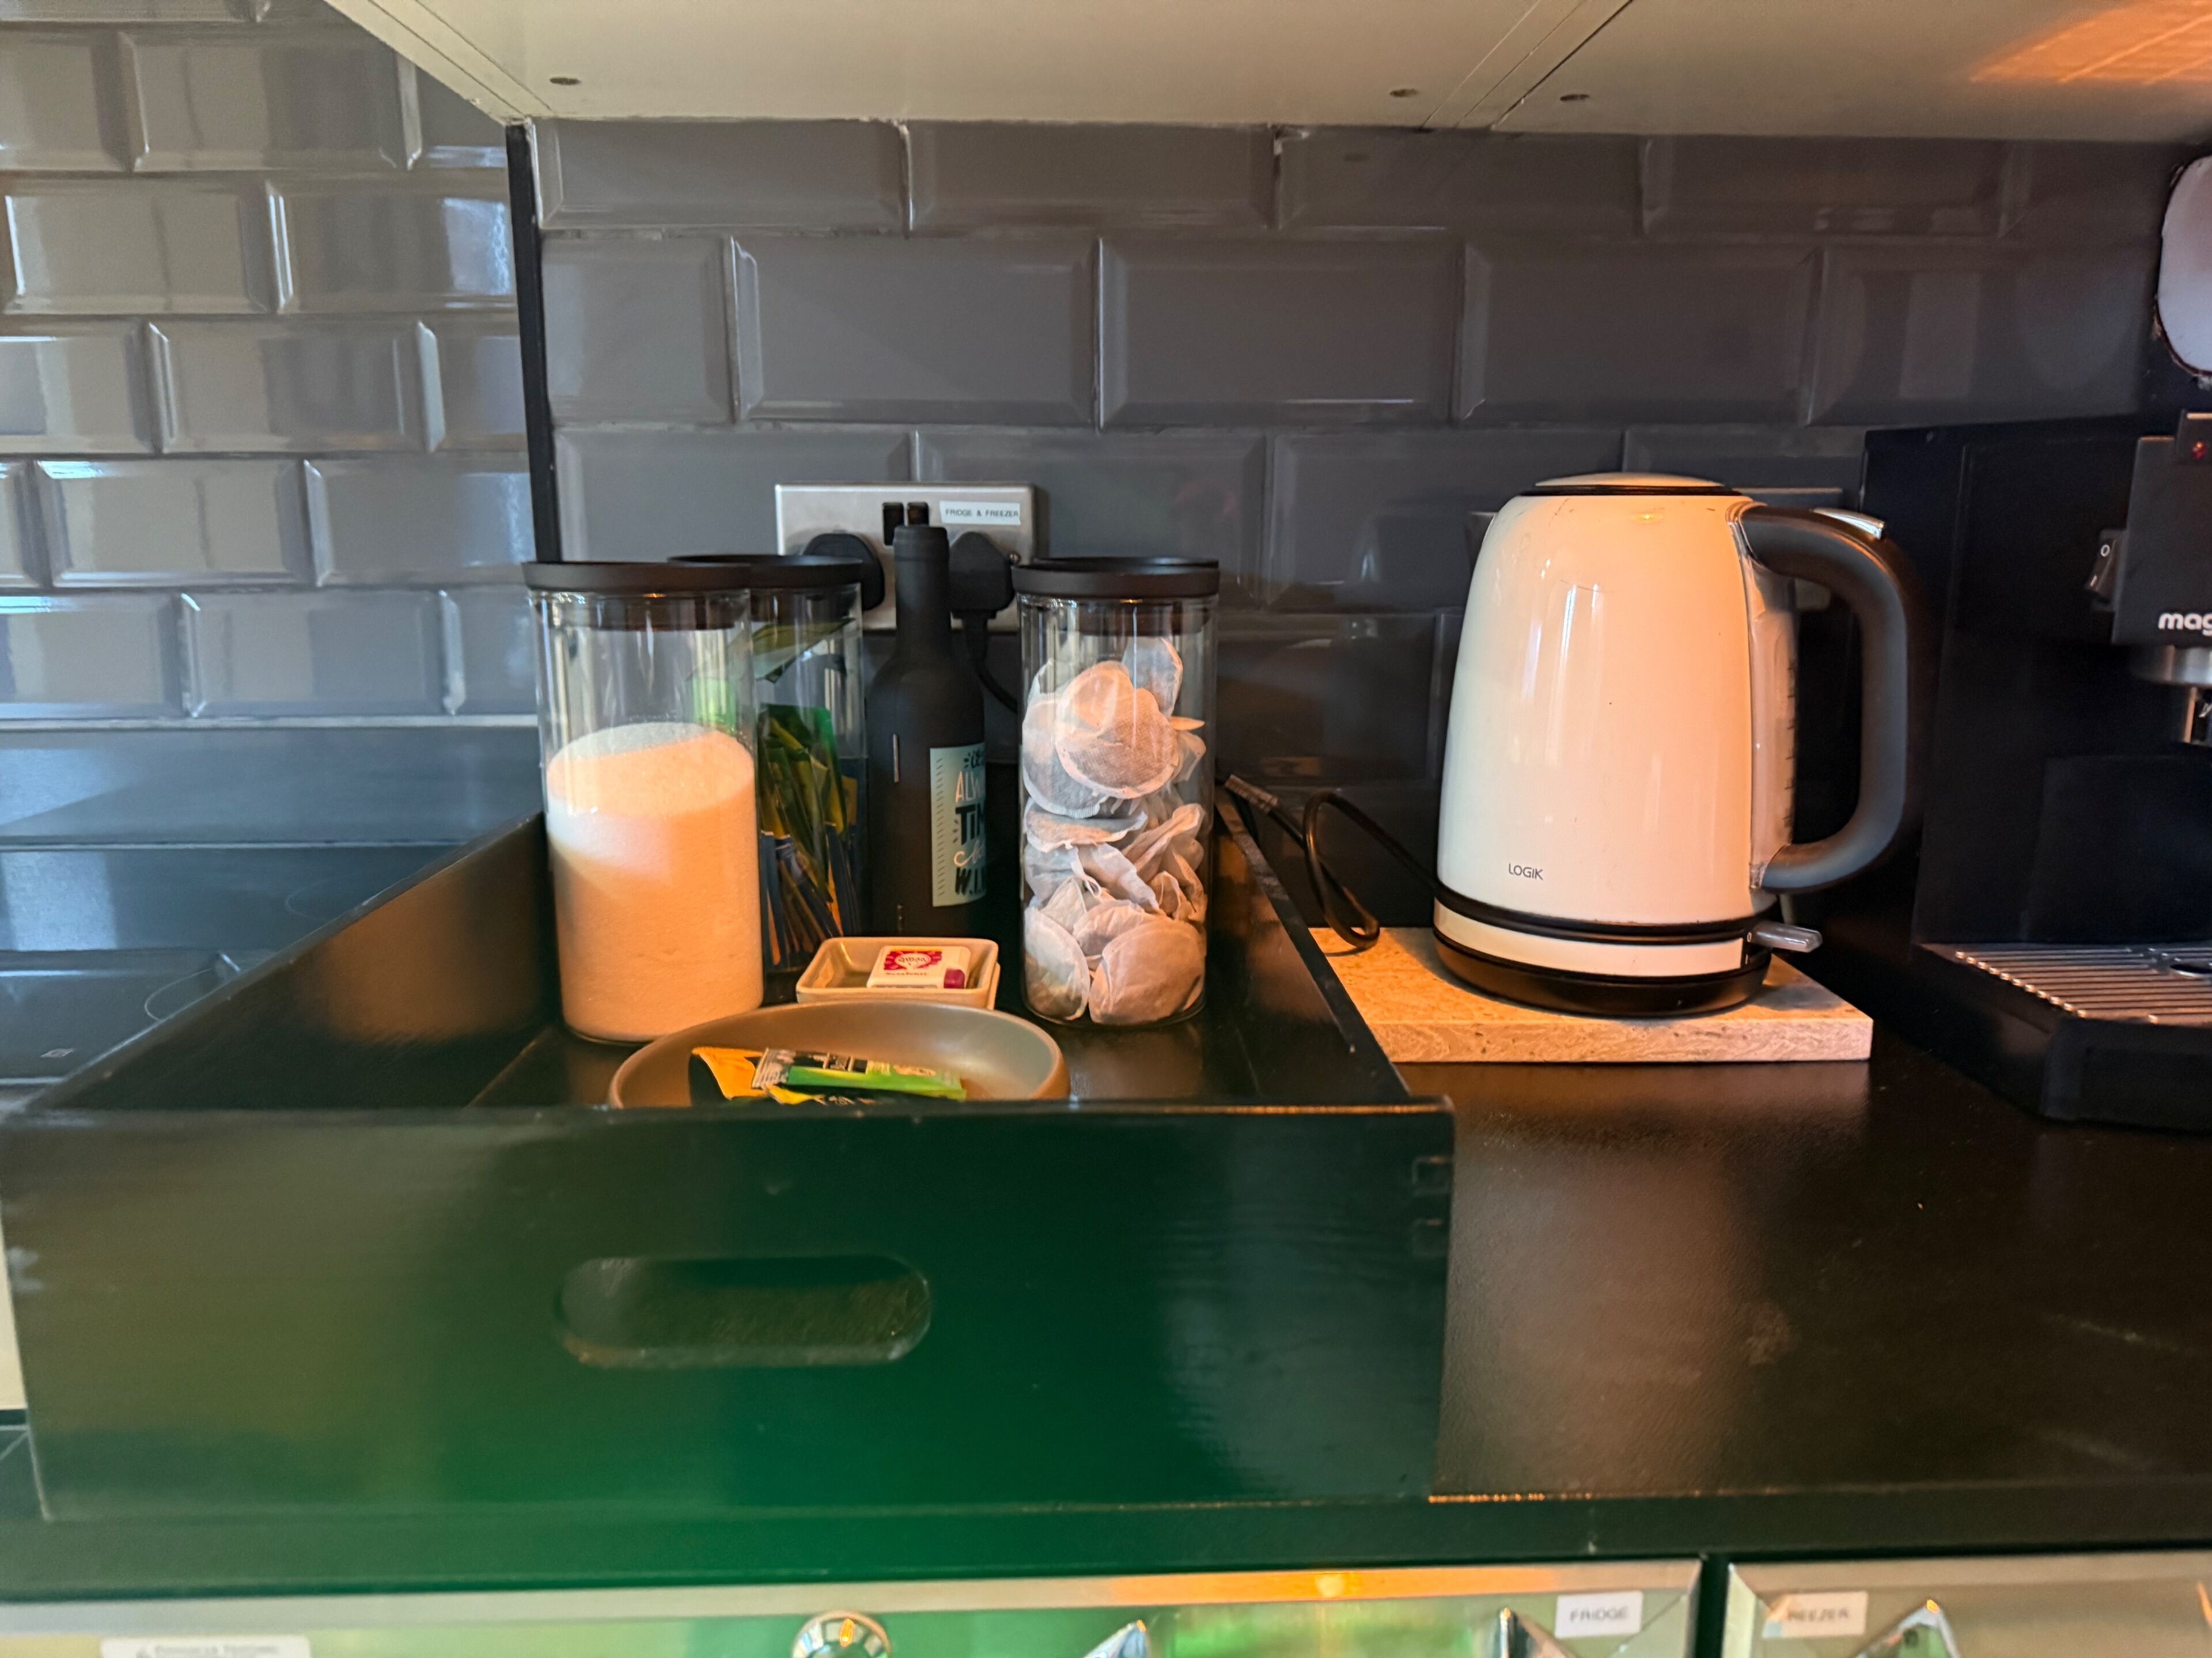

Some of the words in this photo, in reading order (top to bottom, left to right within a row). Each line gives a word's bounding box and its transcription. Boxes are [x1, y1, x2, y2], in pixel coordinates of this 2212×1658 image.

[945, 509, 972, 517] FRIDGE
[985, 509, 1019, 517] FREEZER
[1508, 863, 1543, 880] LOGIK
[1569, 1606, 1628, 1623] FRIDGE
[1781, 1607, 1849, 1622] REEZER
